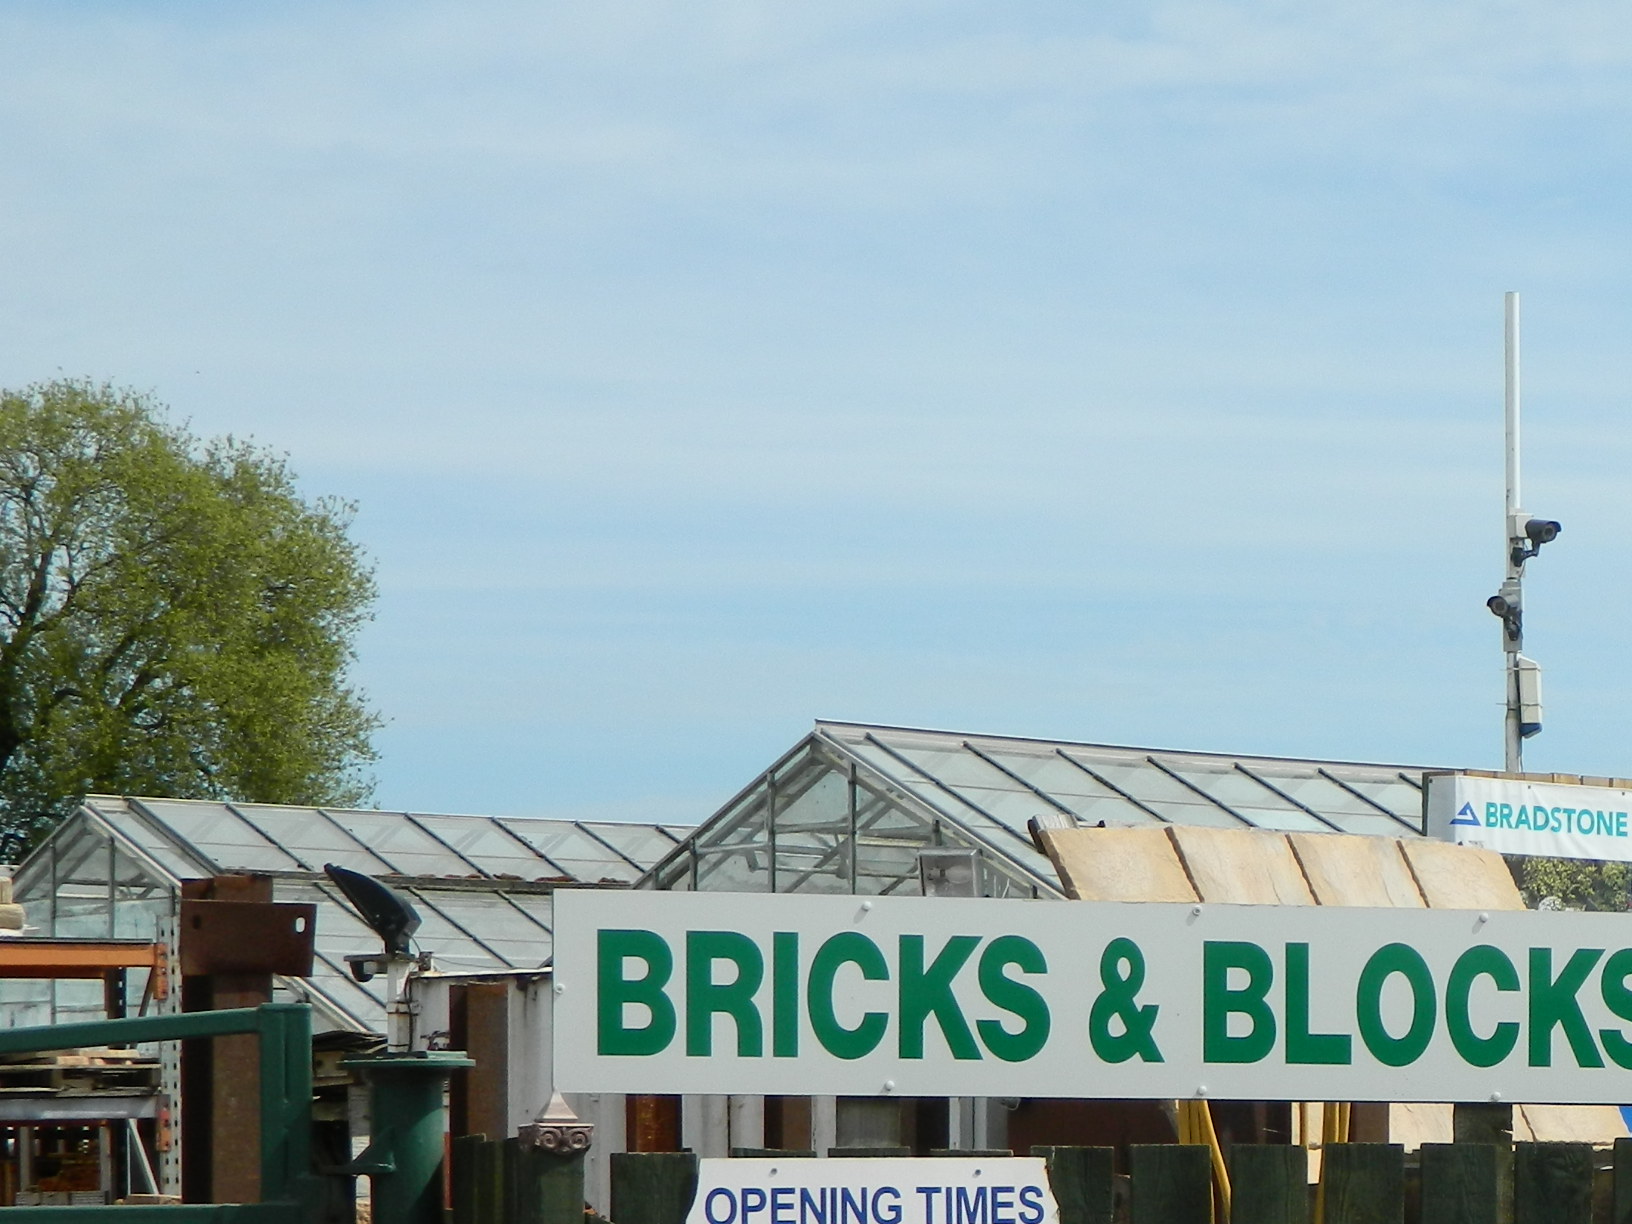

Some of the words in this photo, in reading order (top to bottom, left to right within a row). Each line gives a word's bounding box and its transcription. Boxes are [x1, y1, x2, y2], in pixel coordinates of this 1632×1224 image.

[1485, 802, 1628, 837] BRADSTONE
[597, 929, 1051, 1062] BRICKS
[1089, 937, 1165, 1063] &
